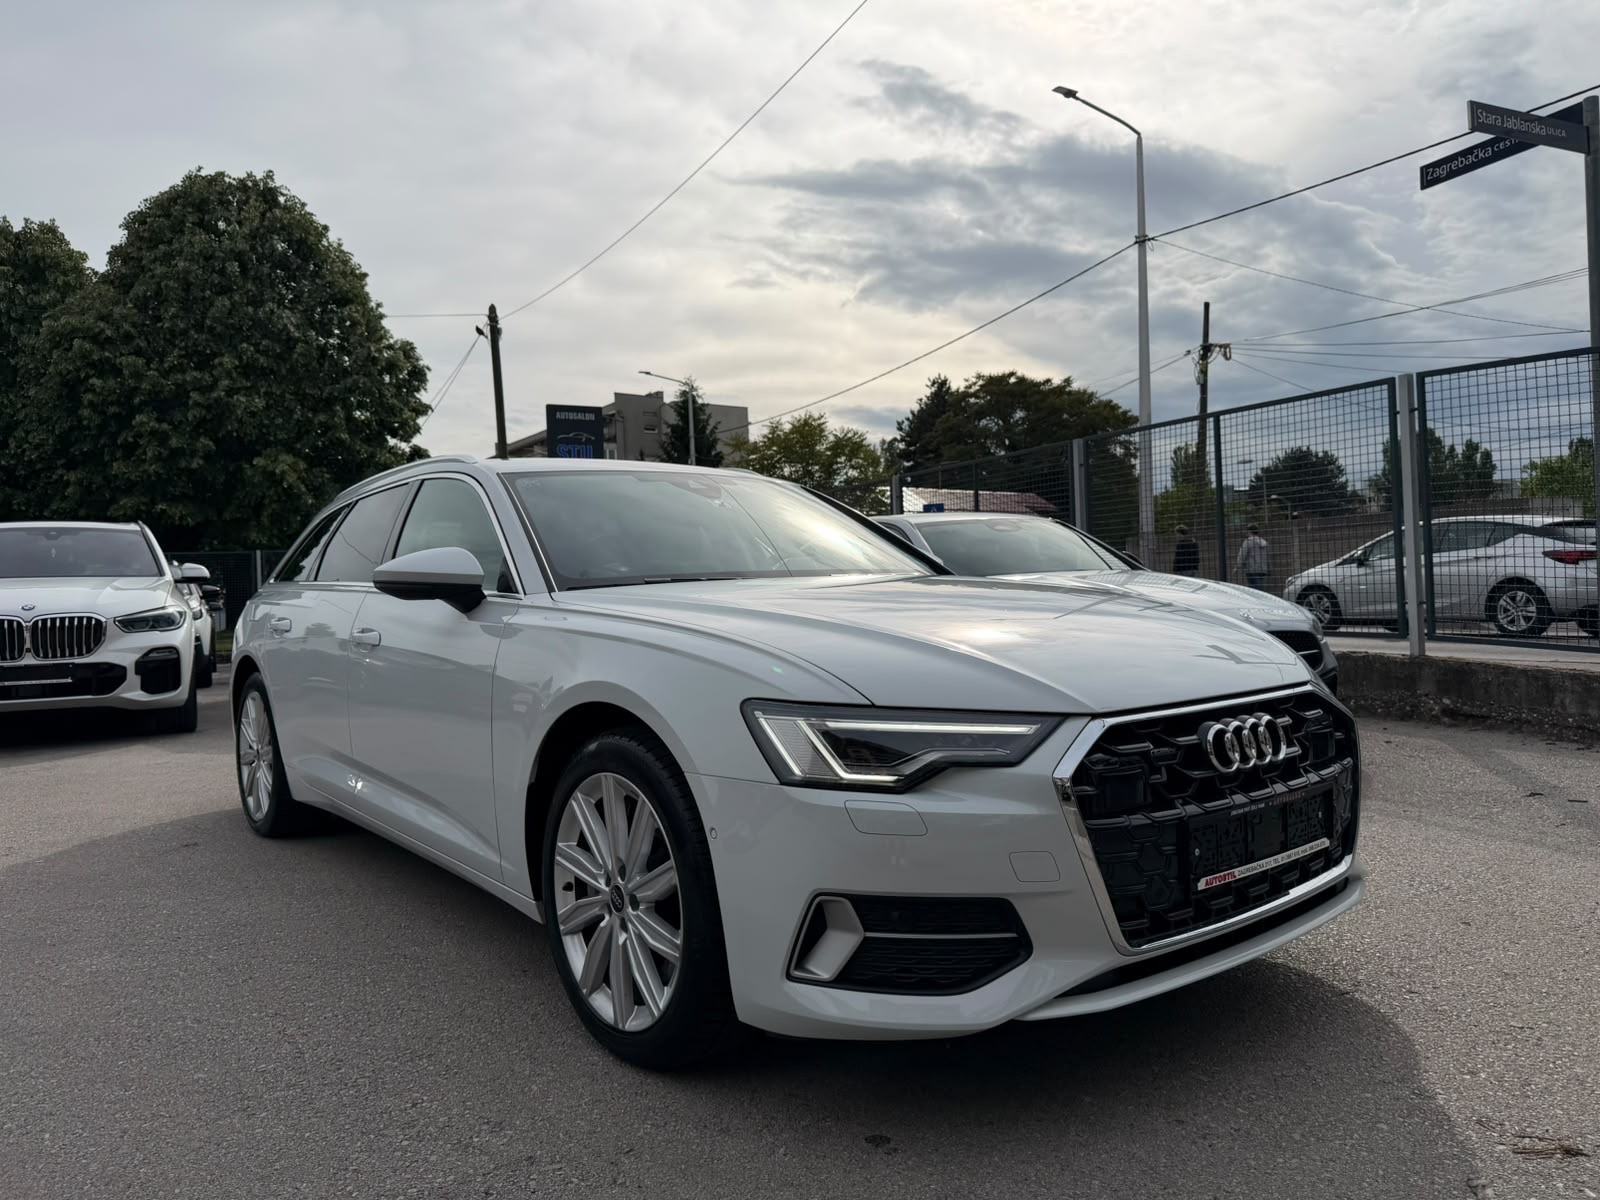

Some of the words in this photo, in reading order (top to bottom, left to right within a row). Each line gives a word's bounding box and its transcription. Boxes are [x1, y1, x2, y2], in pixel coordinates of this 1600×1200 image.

[1477, 108, 1502, 125] Stara
[1503, 113, 1546, 136] Jablanska
[1426, 146, 1492, 180] Zagrebačka
[556, 411, 595, 421] AUTOSALON
[1205, 871, 1237, 887] AUTOSTIL
